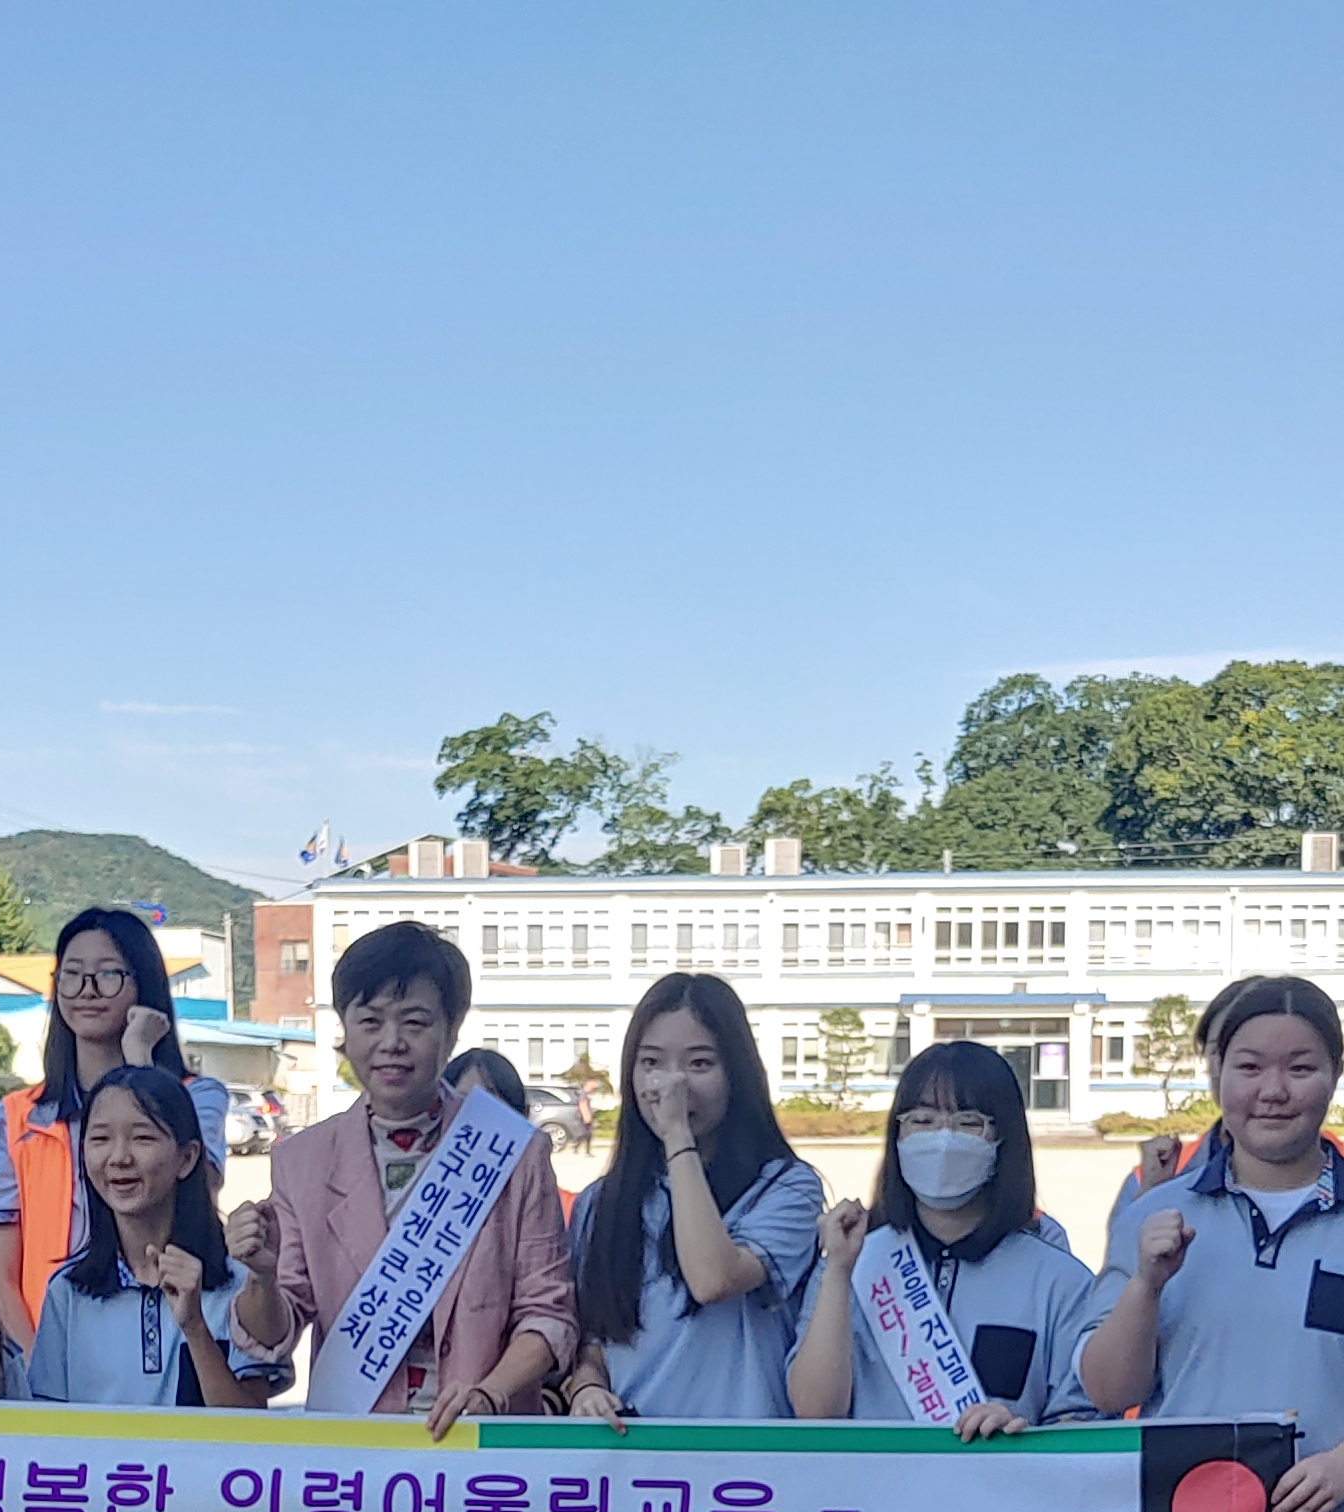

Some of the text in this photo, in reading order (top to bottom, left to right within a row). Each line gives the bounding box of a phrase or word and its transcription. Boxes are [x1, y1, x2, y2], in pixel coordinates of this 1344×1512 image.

[402, 1124, 482, 1249] 친구에겐
[435, 1132, 515, 1257] 나에게는
[339, 1284, 389, 1349] 상처
[890, 1244, 931, 1311] 길을
[919, 1312, 969, 1386] 건널
